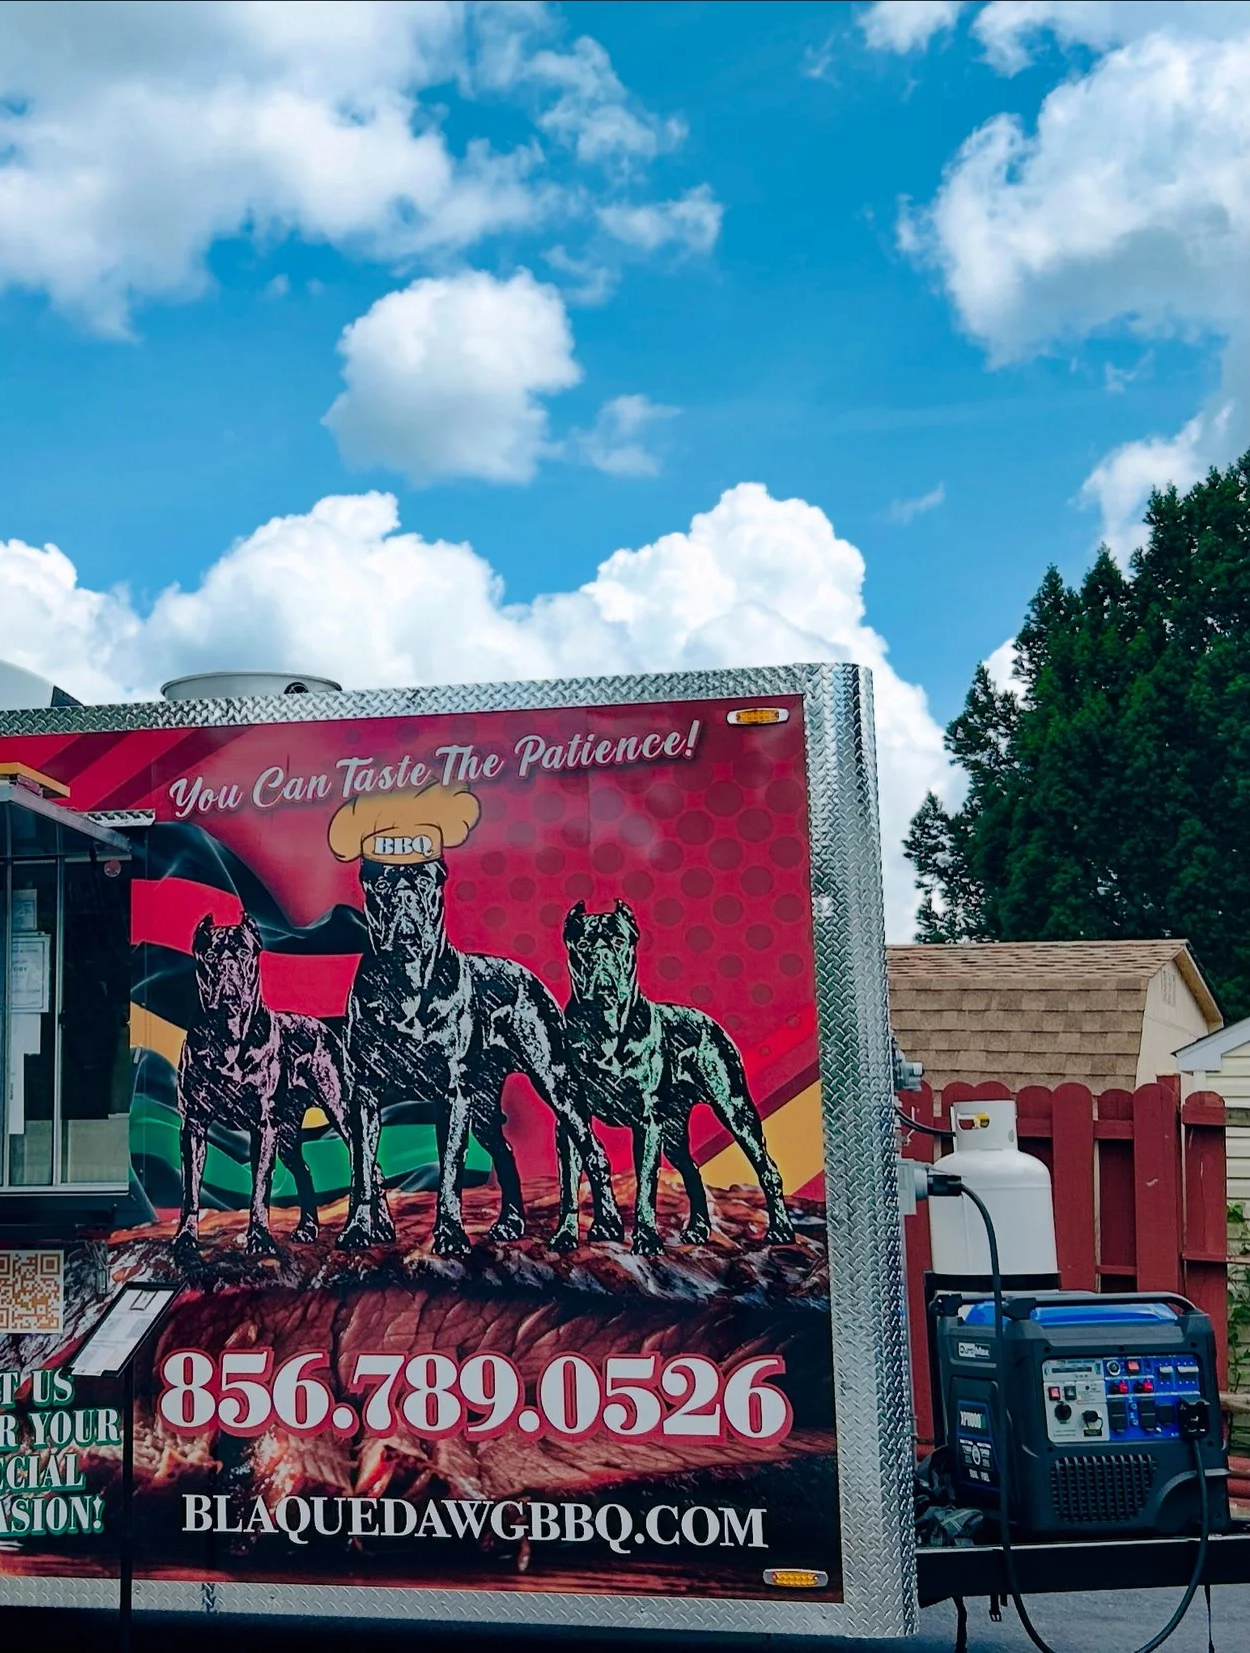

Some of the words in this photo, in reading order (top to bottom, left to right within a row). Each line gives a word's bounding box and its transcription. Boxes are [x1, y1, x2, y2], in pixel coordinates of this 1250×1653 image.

[168, 776, 244, 819] You
[252, 765, 332, 808] Can
[335, 754, 432, 798] Taste
[435, 744, 505, 786] The
[513, 719, 701, 777] Patience!
[373, 835, 433, 857] BBQ
[31, 1368, 74, 1404] US
[158, 1349, 790, 1443] 856.789.0526
[29, 1408, 121, 1447] YOUR
[181, 1494, 771, 1554] BLAQUEDAWGBBQ.COM
